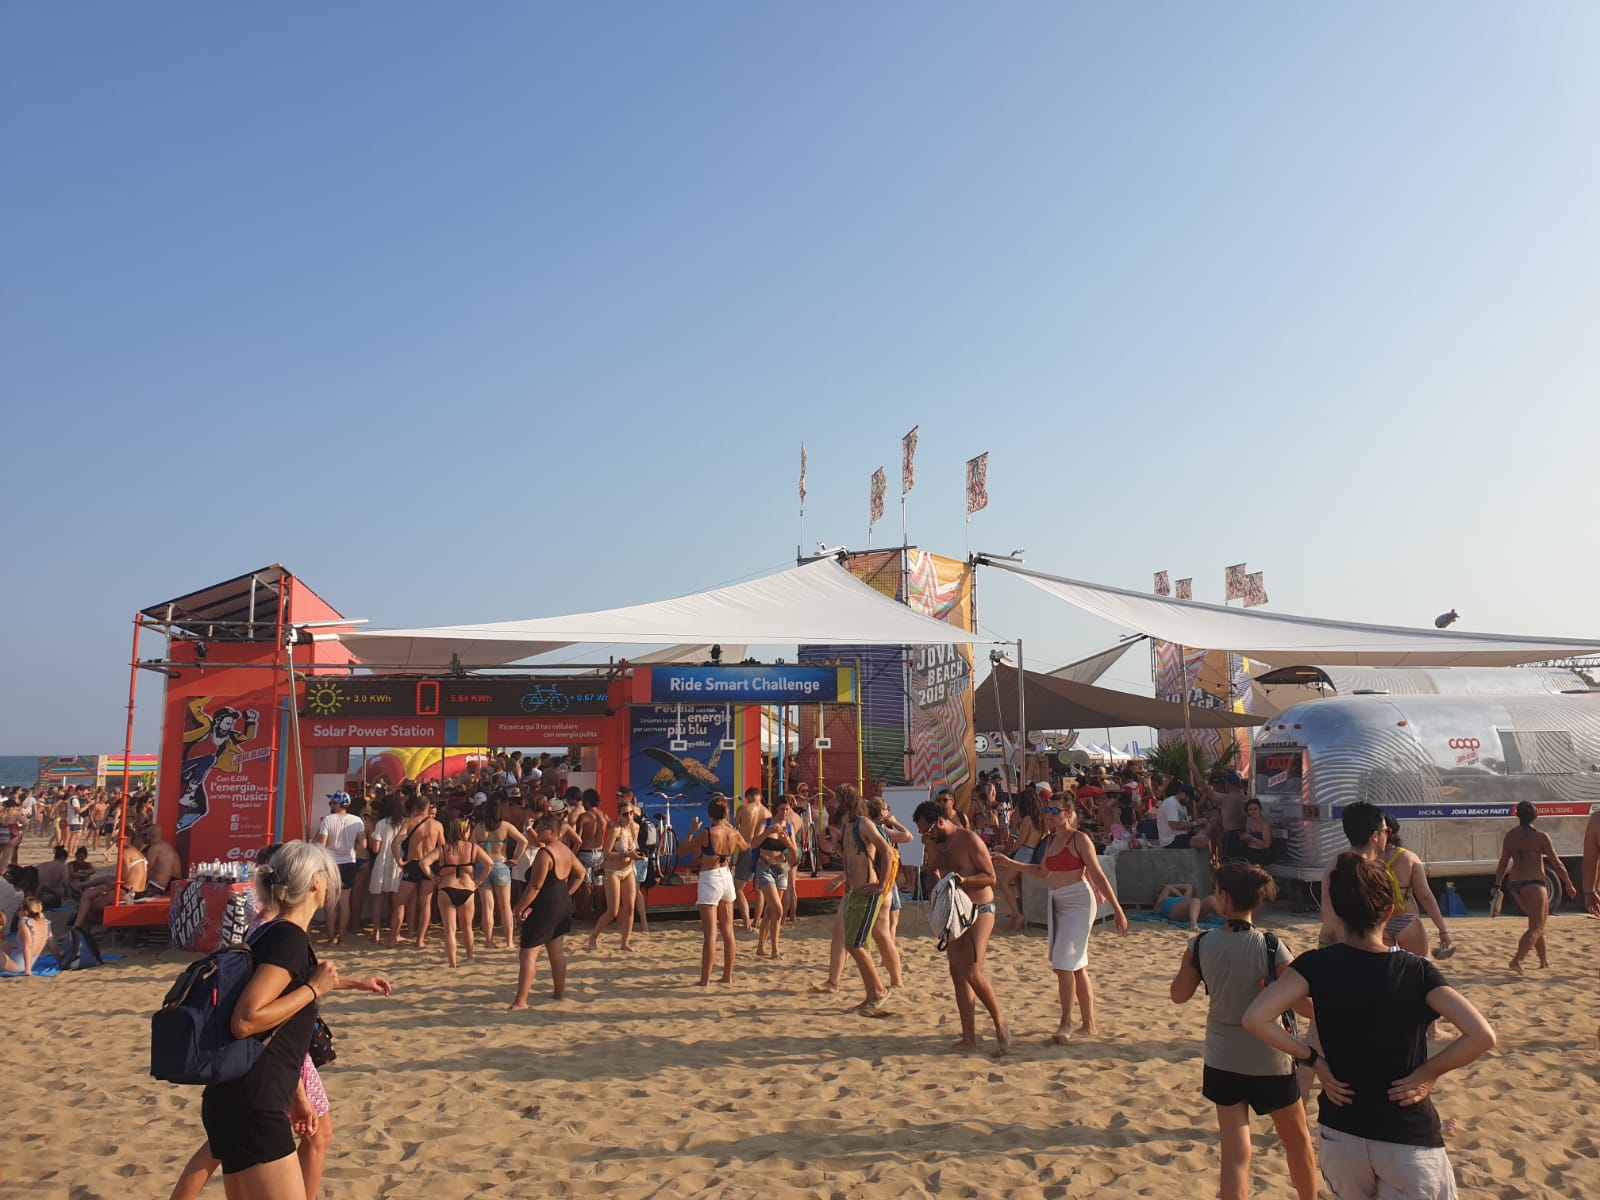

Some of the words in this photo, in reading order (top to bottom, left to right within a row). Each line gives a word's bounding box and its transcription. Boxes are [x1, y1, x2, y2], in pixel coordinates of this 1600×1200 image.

[916, 645, 955, 671] JOVA
[927, 660, 963, 688] BEACH
[670, 677, 702, 691] Ride
[705, 677, 749, 691] Smart
[751, 677, 820, 694] Challenge
[370, 694, 391, 703] KWh
[577, 694, 594, 702] 0.67
[918, 684, 945, 706] 2019
[313, 724, 345, 737] Solar
[348, 725, 388, 737] Power
[390, 724, 435, 737] Station
[525, 723, 535, 732] qui
[688, 724, 707, 735] blu
[1449, 738, 1480, 751] coop
[210, 782, 256, 793] l'energia
[178, 898, 206, 946] JOVA
[231, 892, 248, 944] BEACH
